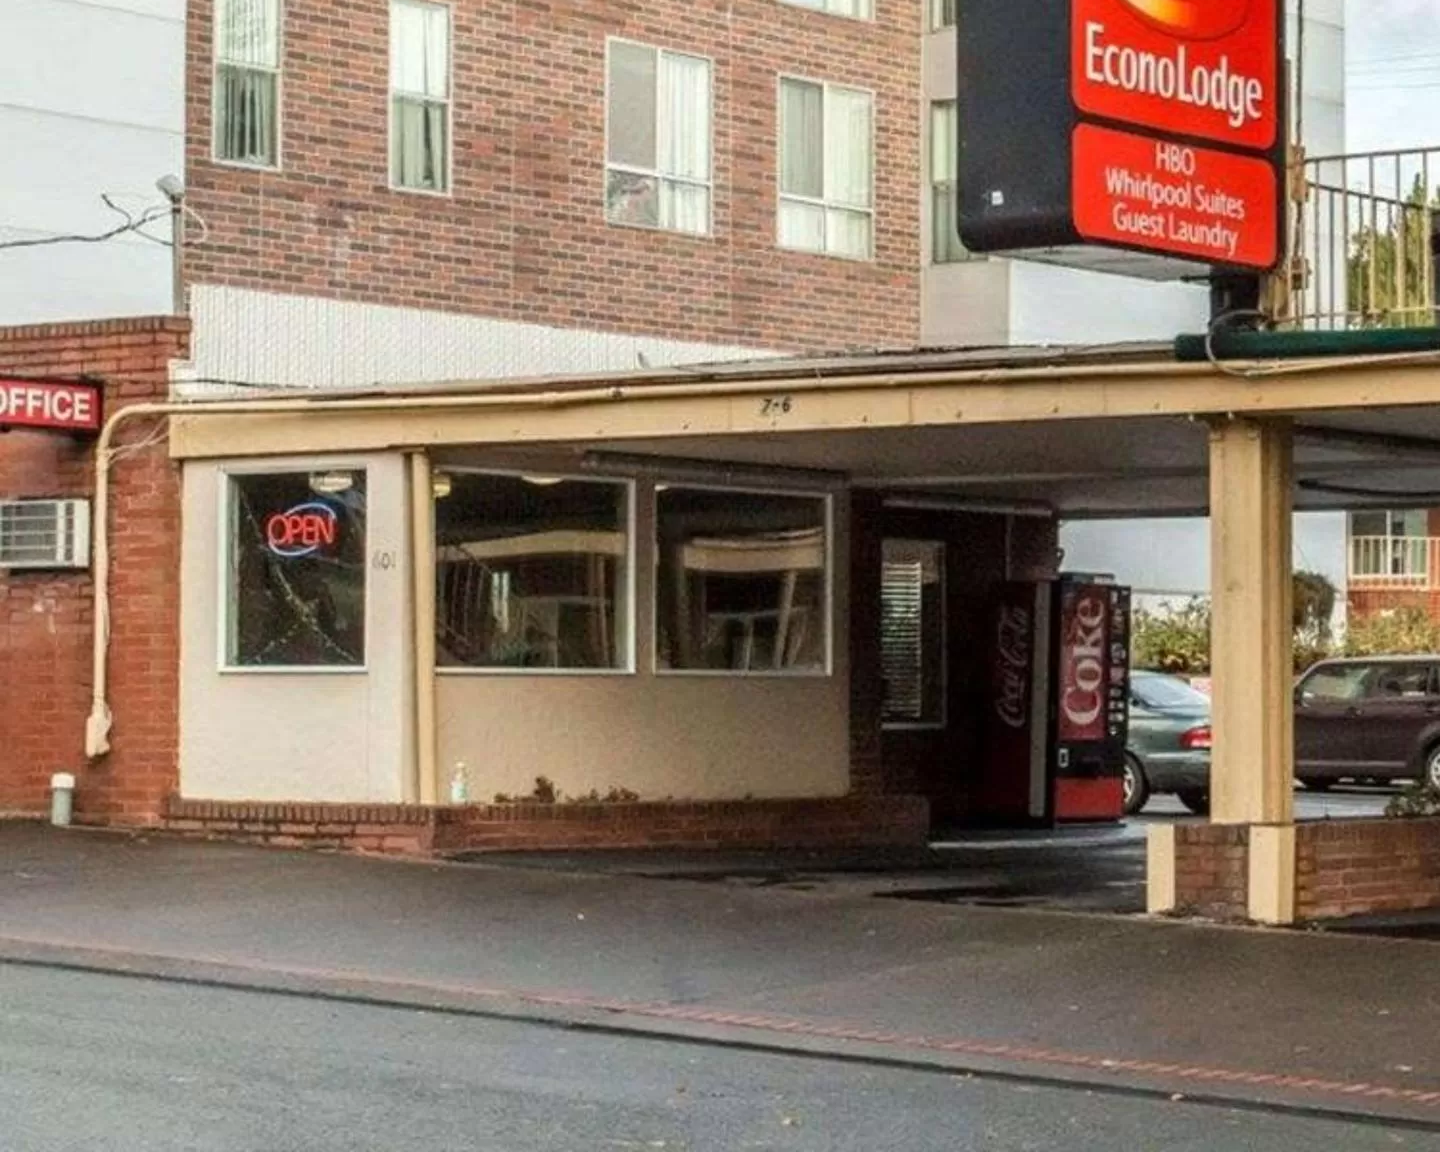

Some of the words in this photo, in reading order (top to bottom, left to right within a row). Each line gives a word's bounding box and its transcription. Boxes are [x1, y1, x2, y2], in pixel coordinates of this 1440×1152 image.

[1085, 21, 1264, 128] EconoLodge
[1155, 142, 1196, 176] HBO
[1105, 167, 1191, 209] Whirlpool
[1194, 184, 1245, 220] Suites
[1113, 201, 1165, 238] Guest
[1168, 213, 1239, 258] Laundry
[267, 514, 334, 545] OPEN
[1064, 598, 1104, 725] Coke
